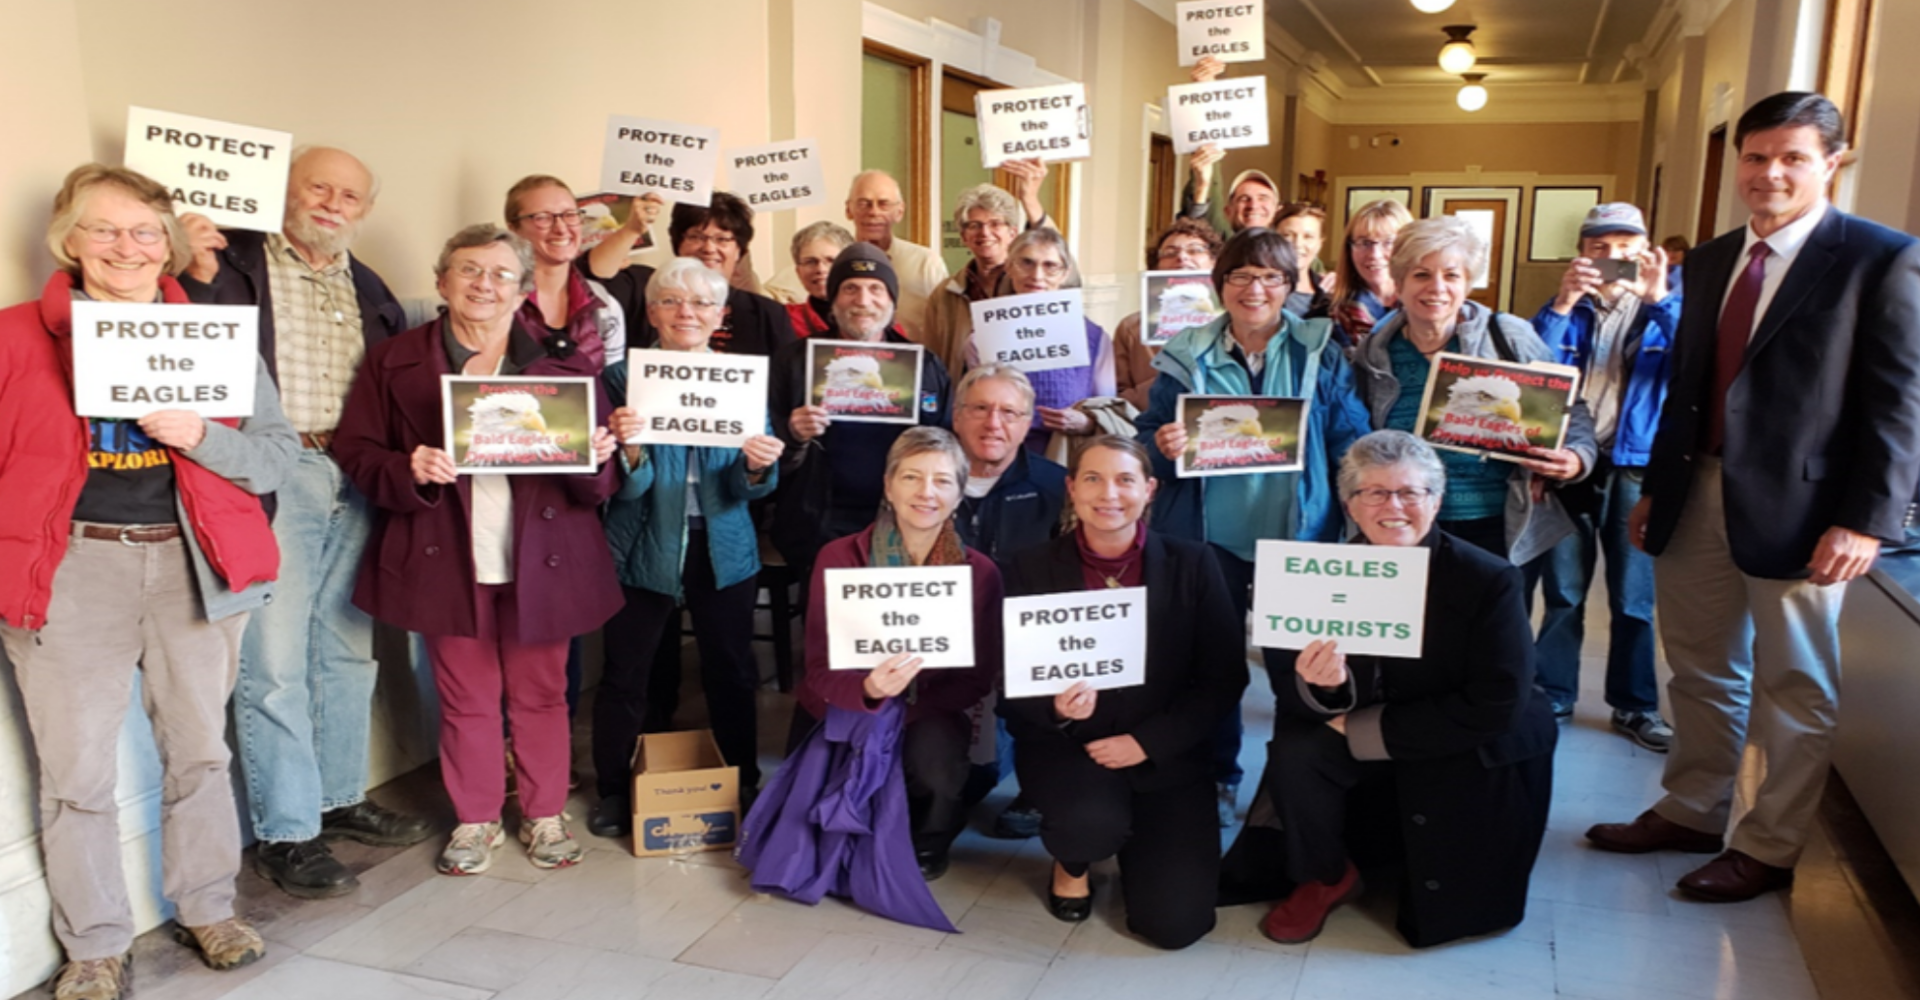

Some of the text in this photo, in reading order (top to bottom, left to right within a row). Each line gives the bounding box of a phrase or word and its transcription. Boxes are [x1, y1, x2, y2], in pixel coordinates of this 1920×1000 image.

[1186, 5, 1254, 21] PROTECT
[1208, 26, 1231, 37] the
[1192, 41, 1250, 56] EAGLES
[992, 95, 1073, 114] PROTECT
[1179, 87, 1255, 106] PROTECT
[1205, 109, 1231, 121] the
[1020, 119, 1048, 131] the
[1188, 125, 1252, 142] EAGLES
[146, 125, 275, 160] PROTECT
[618, 127, 708, 150] PROTECT
[1002, 136, 1071, 154] EAGLES
[644, 153, 675, 168] the
[735, 148, 809, 169] PROTECT
[187, 162, 230, 182] the
[763, 170, 789, 184] the
[620, 171, 695, 193] EAGLES
[171, 187, 258, 214] AGLES
[748, 186, 811, 205] EAGLES
[983, 300, 1071, 323] PROTECT
[96, 320, 239, 339] PROTECT
[1016, 327, 1046, 339] the
[996, 344, 1070, 362] EAGLES
[147, 354, 195, 372] the
[644, 364, 754, 384] PROTECT
[1439, 359, 1571, 391] Help us Protect the
[110, 385, 228, 403] EAGLES
[479, 384, 558, 395] Protect the
[826, 388, 900, 400] Bald Eagles of
[680, 392, 716, 408] the
[651, 417, 743, 435] EAGLES
[1445, 413, 1542, 438] Bald Eagles of
[474, 433, 570, 447] Bald Eagles of
[1200, 437, 1281, 450] Bald Eagles of
[1285, 557, 1399, 579] EAGLES
[842, 581, 957, 599] PROTECT
[1331, 594, 1347, 604] =
[882, 611, 920, 626] the
[1019, 603, 1132, 626] PROTECT
[1266, 615, 1410, 640] TOURISTS
[855, 637, 950, 654] EAGLES
[1059, 635, 1096, 651] the
[1031, 658, 1124, 681] EAGLES
[654, 787, 685, 795] Thank
